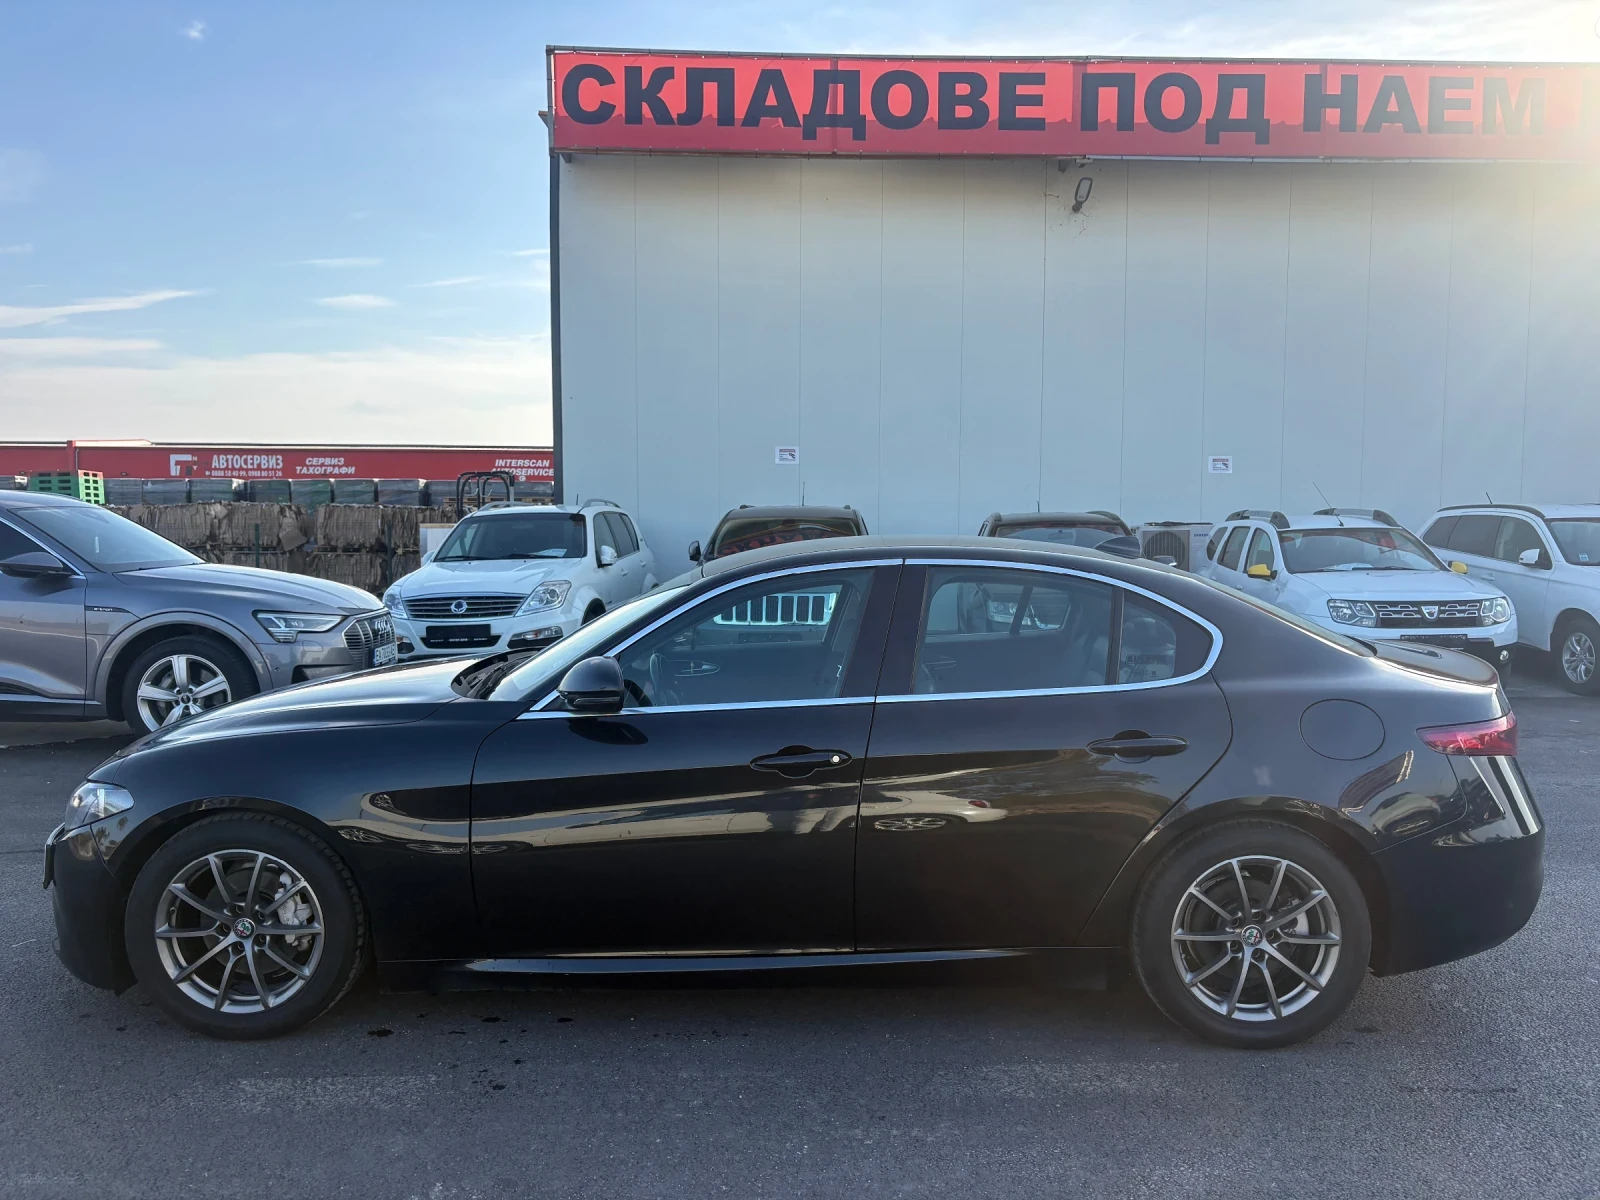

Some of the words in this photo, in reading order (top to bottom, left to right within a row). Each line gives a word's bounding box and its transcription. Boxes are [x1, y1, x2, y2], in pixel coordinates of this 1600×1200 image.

[561, 63, 1046, 141] СКЛАДОВЕ
[1080, 72, 1271, 145] ПОД
[1302, 73, 1547, 136] НАЕМ
[211, 454, 284, 469] АВТОСЕРВИЗ
[305, 457, 345, 465] СЕРВИЗ
[495, 459, 550, 467] INTERSCAN
[295, 466, 356, 475] ТАХОГРАФИ
